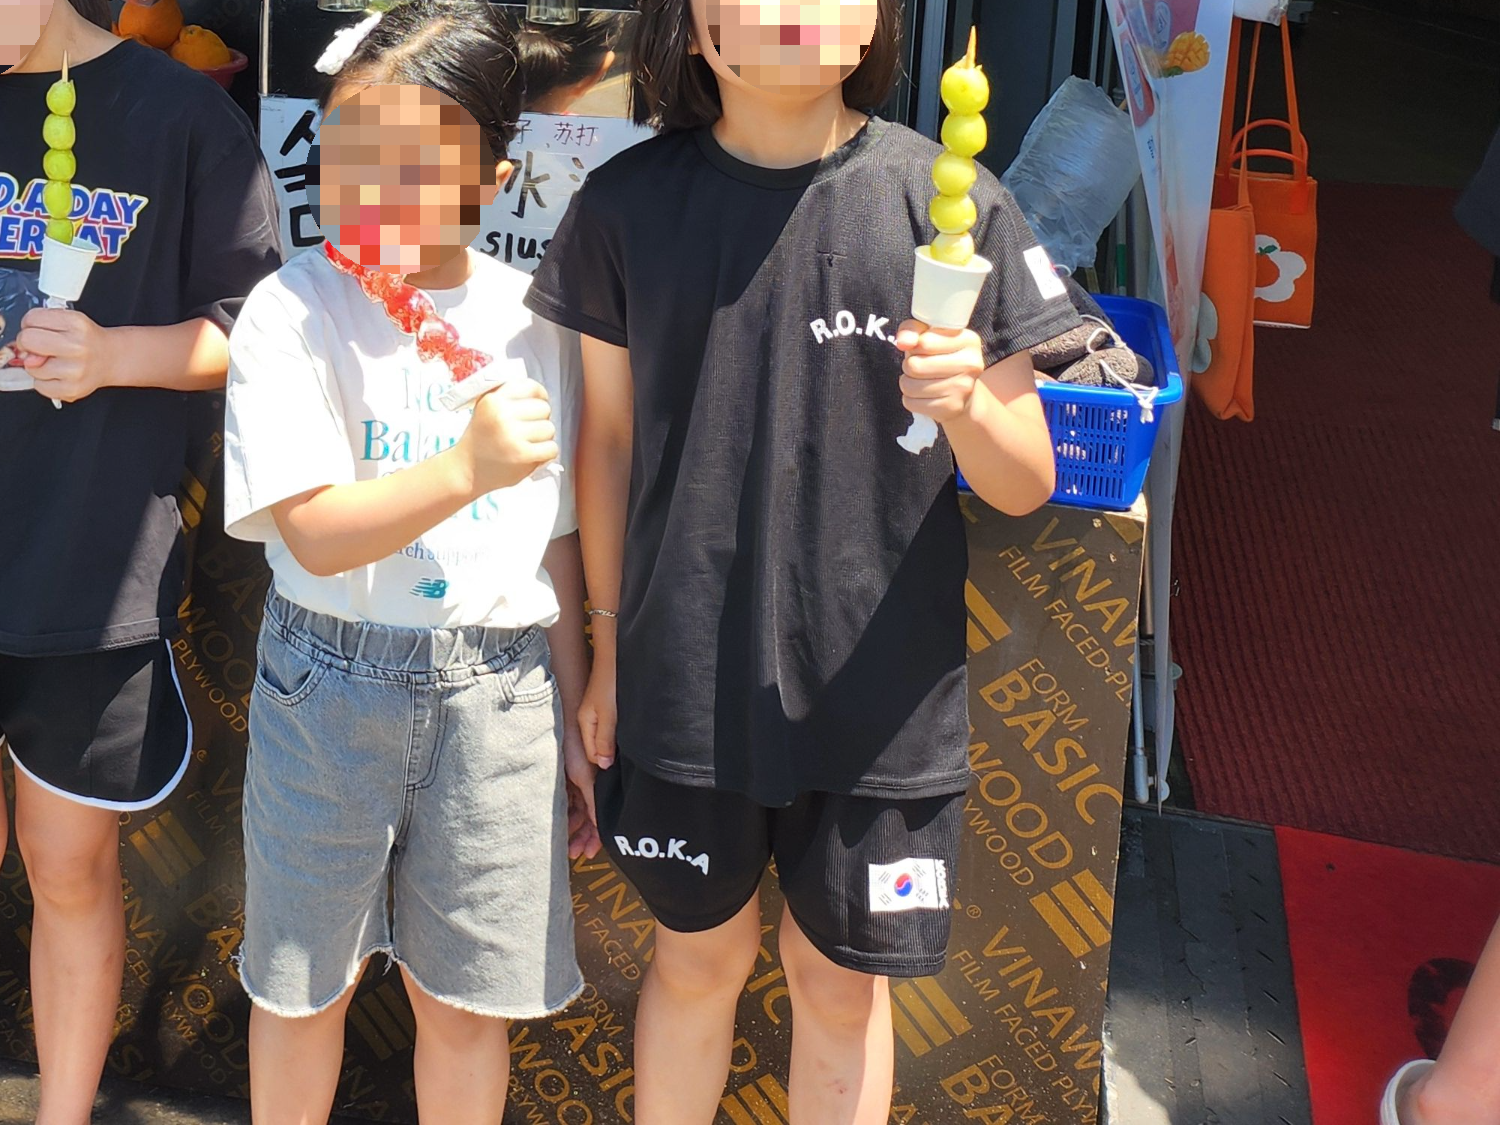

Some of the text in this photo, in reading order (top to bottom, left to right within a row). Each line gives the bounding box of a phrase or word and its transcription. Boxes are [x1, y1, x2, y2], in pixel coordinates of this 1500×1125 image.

[998, 545, 1110, 670] FILM FACED
[171, 638, 248, 735] PLYWOOD
[1019, 657, 1090, 733] FORM
[979, 669, 1124, 826] BASIC
[614, 835, 710, 876] R.O.K.A
[584, 915, 641, 981] FACED
[580, 981, 625, 1038] ORM
[952, 950, 1001, 1002] FILM
[994, 1003, 1057, 1072] FACED
[982, 925, 1102, 1071] VINAW
